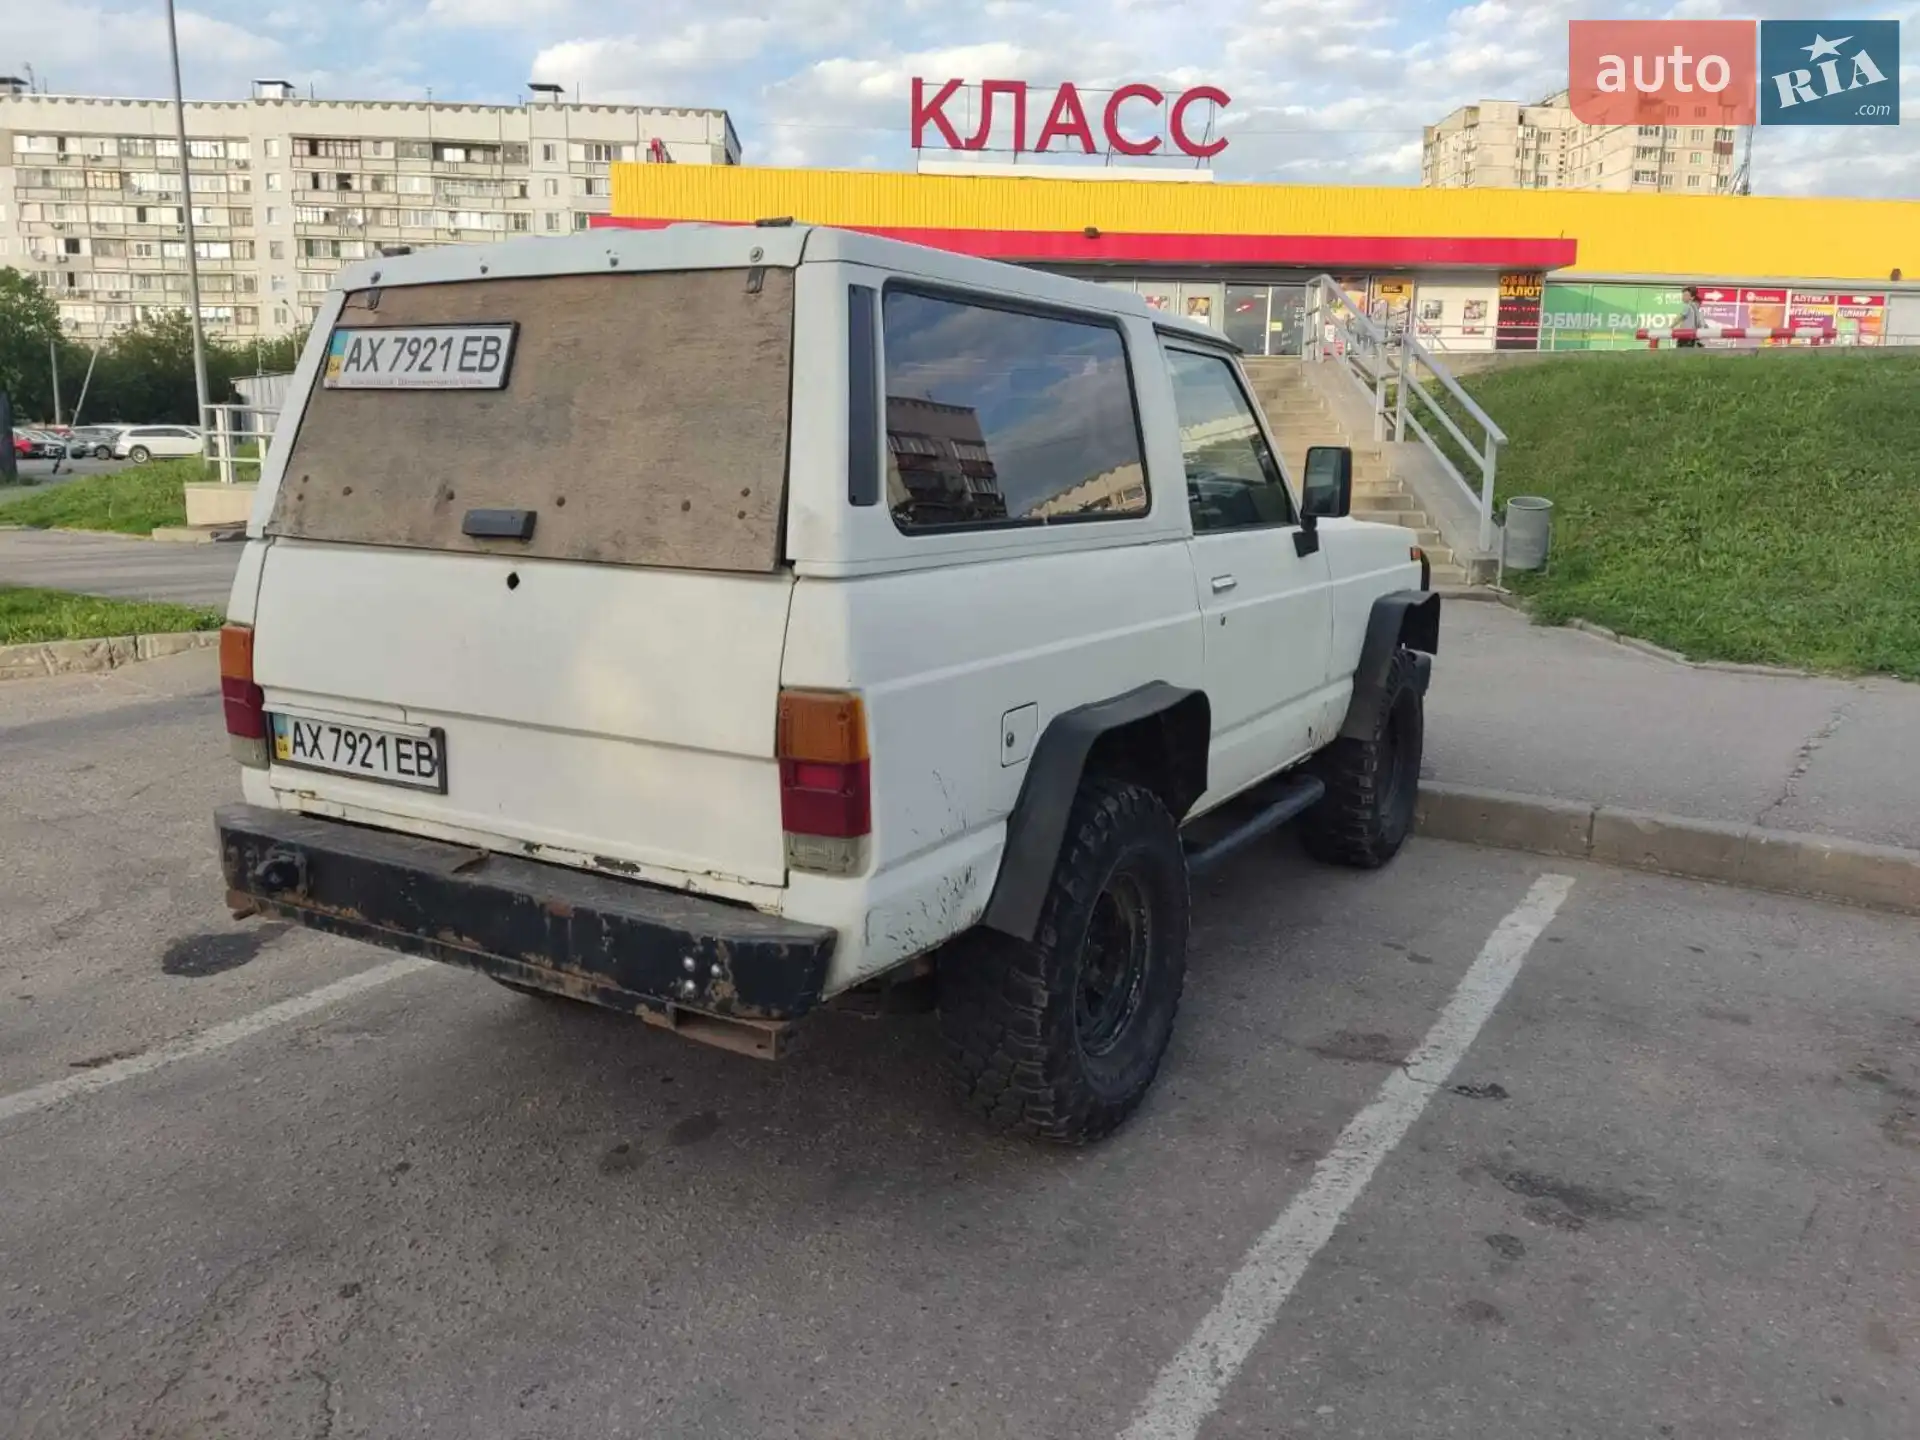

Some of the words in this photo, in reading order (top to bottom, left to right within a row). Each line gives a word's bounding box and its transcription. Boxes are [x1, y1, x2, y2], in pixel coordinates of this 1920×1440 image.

[911, 77, 1231, 157] КЛАСС
[1500, 286, 1542, 296] ВАЛЮТ
[1542, 312, 1603, 329] ОБМІН
[1608, 312, 1678, 329] ВАЛЮТ
[344, 335, 386, 373] AX
[388, 335, 454, 373] 7921
[457, 335, 503, 373] EB
[291, 721, 324, 760] AX
[327, 727, 389, 772] 7921
[395, 737, 437, 778] EB
